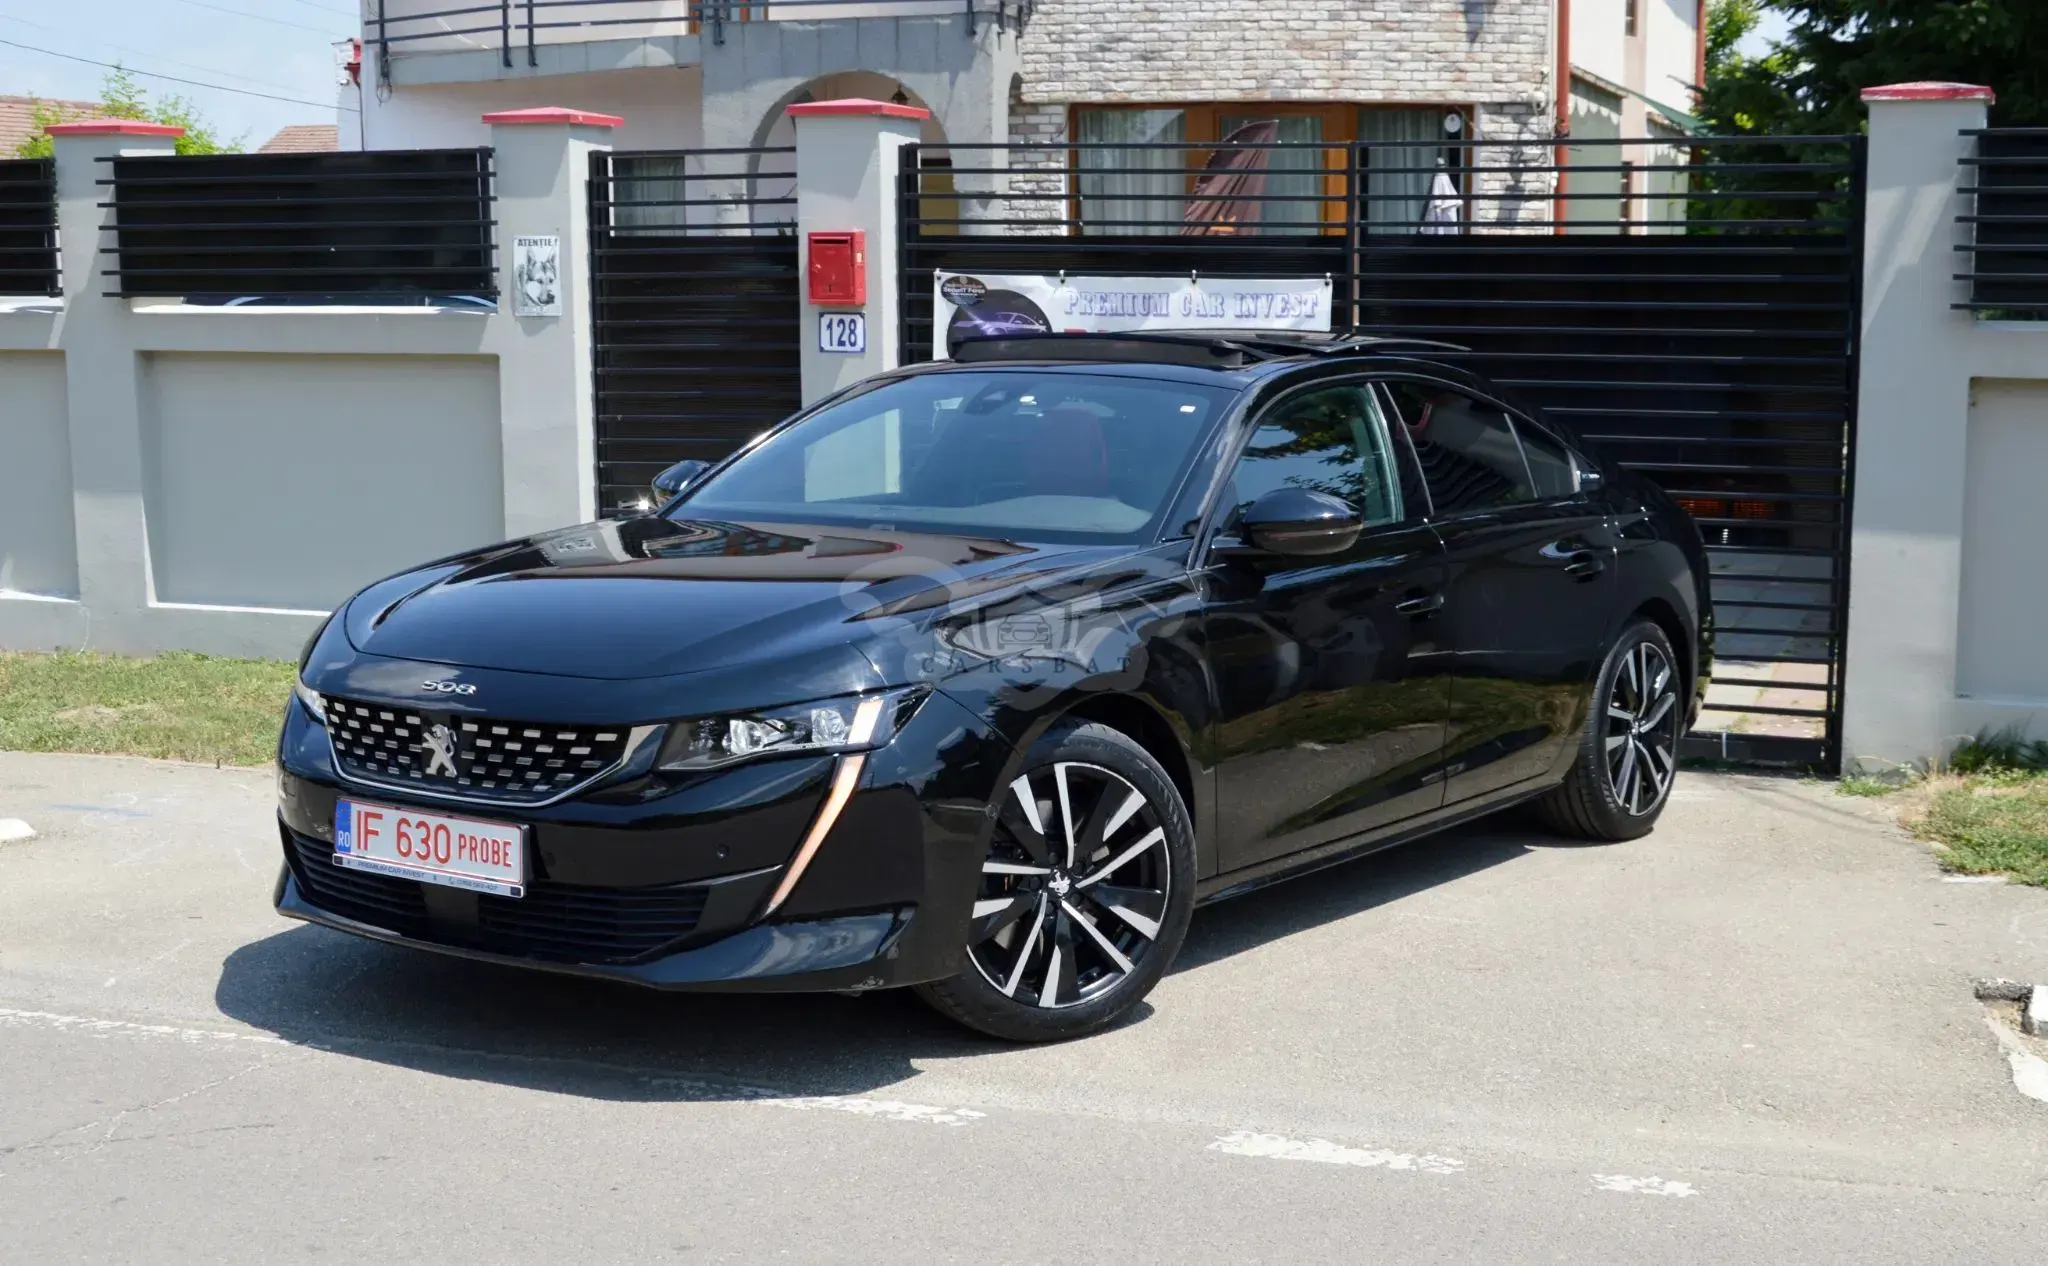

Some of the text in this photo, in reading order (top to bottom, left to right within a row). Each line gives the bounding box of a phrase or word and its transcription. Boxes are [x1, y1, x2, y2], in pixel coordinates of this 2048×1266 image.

[1064, 291, 1319, 319] PREMIUM CAR INVEST
[826, 318, 857, 347] 128
[421, 680, 476, 695] 508
[338, 831, 350, 847] RO
[357, 810, 512, 868] IF 630 PROBE
